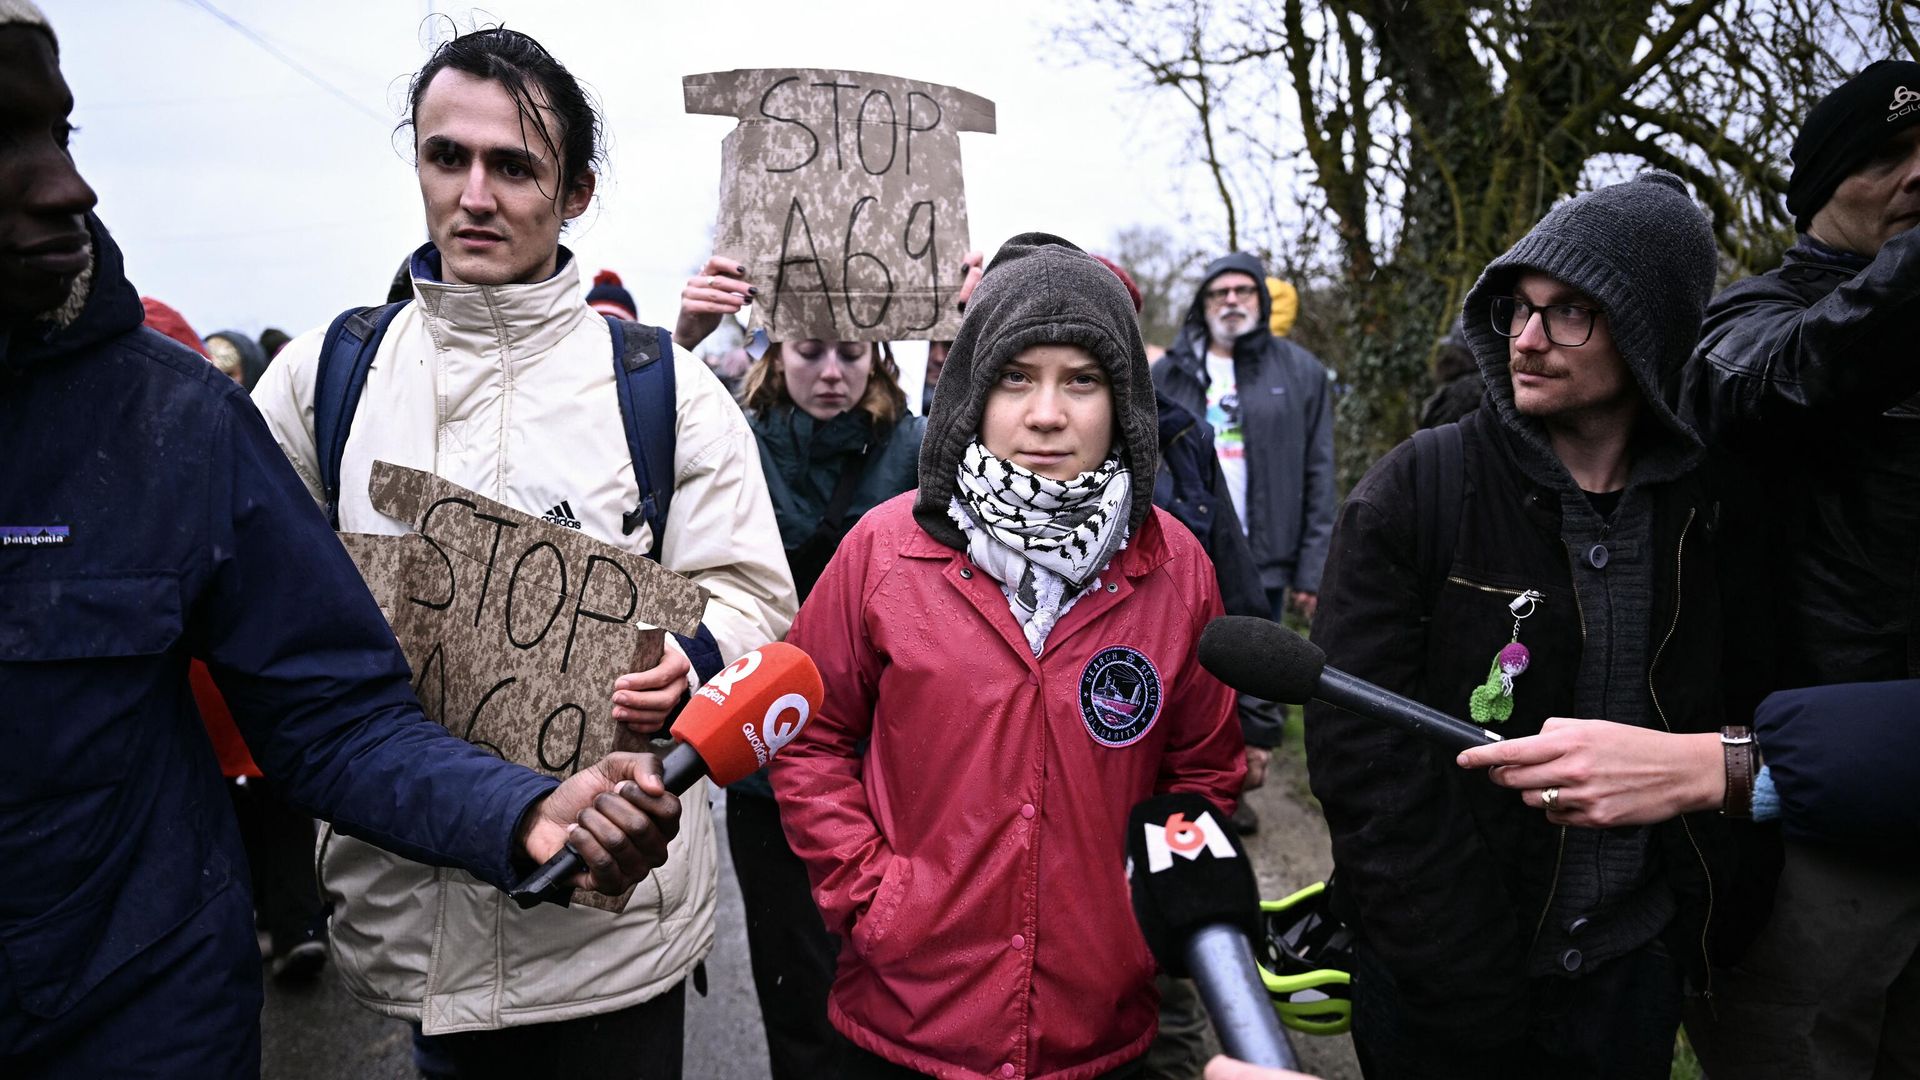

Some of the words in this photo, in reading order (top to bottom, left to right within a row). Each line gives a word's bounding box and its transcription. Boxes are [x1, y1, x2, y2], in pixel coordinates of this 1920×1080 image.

[759, 76, 942, 176] STOP
[1886, 103, 1920, 122] odl
[770, 195, 940, 331] A69
[3, 534, 64, 545] patagonia
[409, 497, 638, 673] STOP
[1085, 652, 1118, 683] SEARCH
[1140, 664, 1157, 709] RESCUE
[1084, 706, 1137, 740] SOLIDARITY
